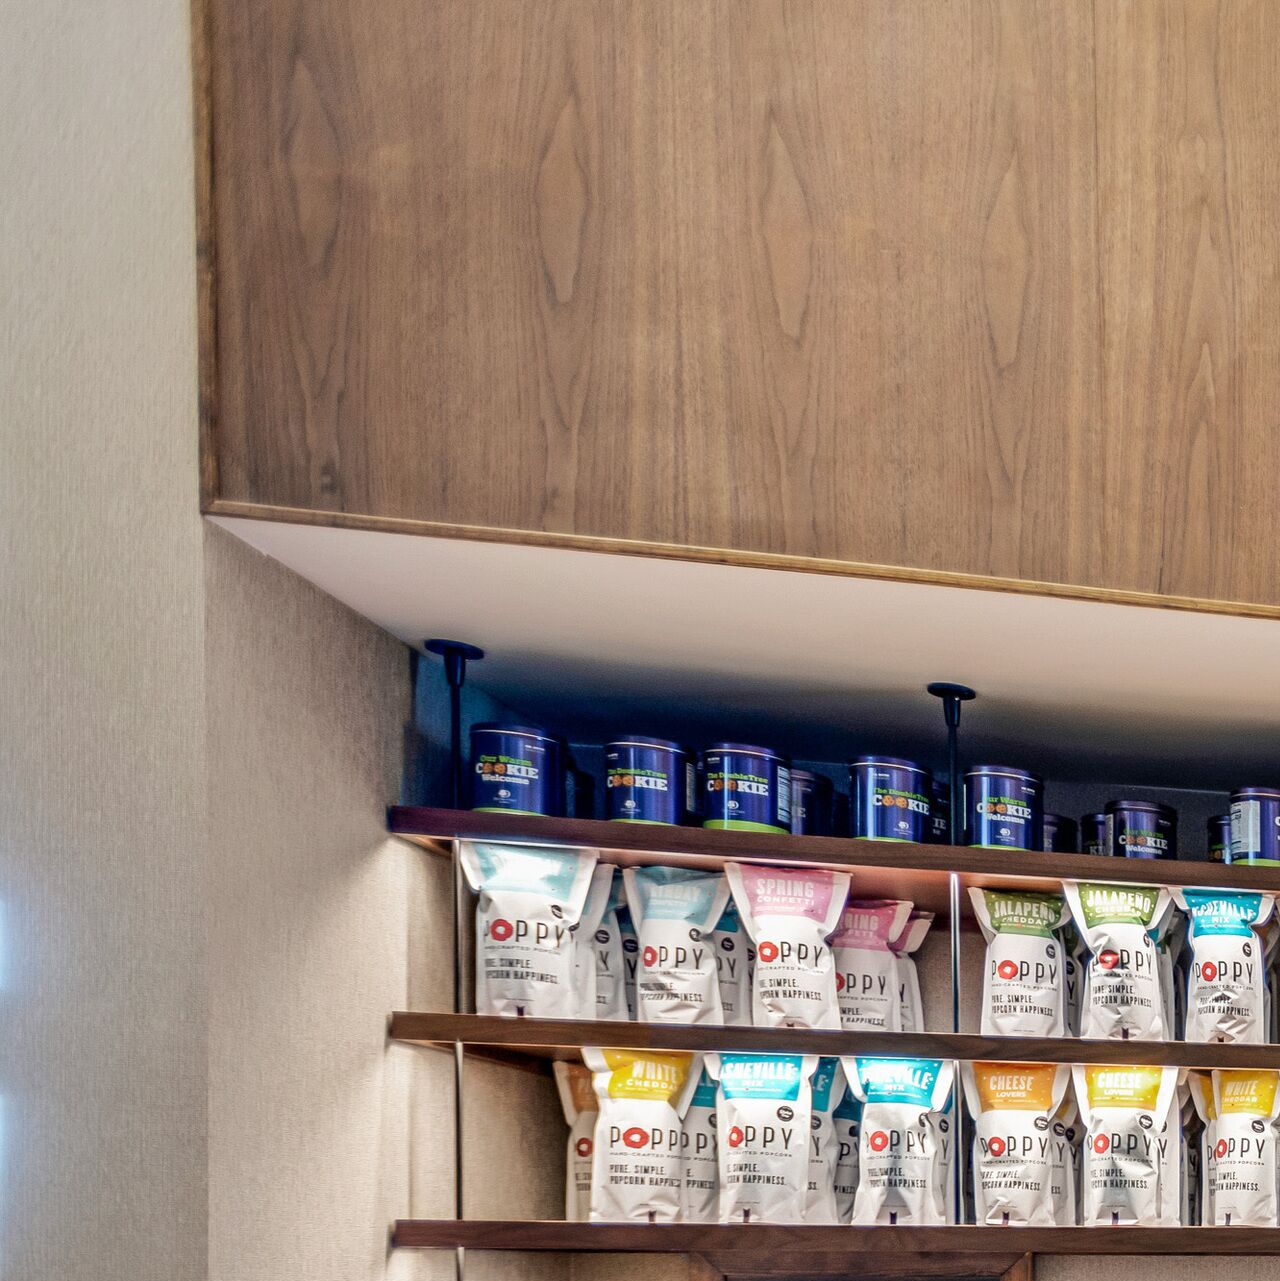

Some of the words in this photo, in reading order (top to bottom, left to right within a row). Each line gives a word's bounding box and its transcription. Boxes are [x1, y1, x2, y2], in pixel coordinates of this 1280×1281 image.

[475, 763, 538, 779] COOKIE
[607, 775, 668, 791] COOKIE
[707, 779, 769, 796] COOKIE
[872, 795, 930, 815] COOKIE
[976, 803, 1031, 819] COOKIE
[756, 878, 814, 897] SPRING
[991, 960, 1057, 985] POPPY
[1194, 961, 1253, 984] POPPY
[632, 1061, 677, 1081] WHITE
[989, 1075, 1035, 1091] CHEESE
[1097, 1072, 1141, 1088] CHEESE
[1225, 1080, 1256, 1095] WHITE
[610, 1126, 679, 1151] POPP
[634, 1165, 666, 1176] SIMPLE.
